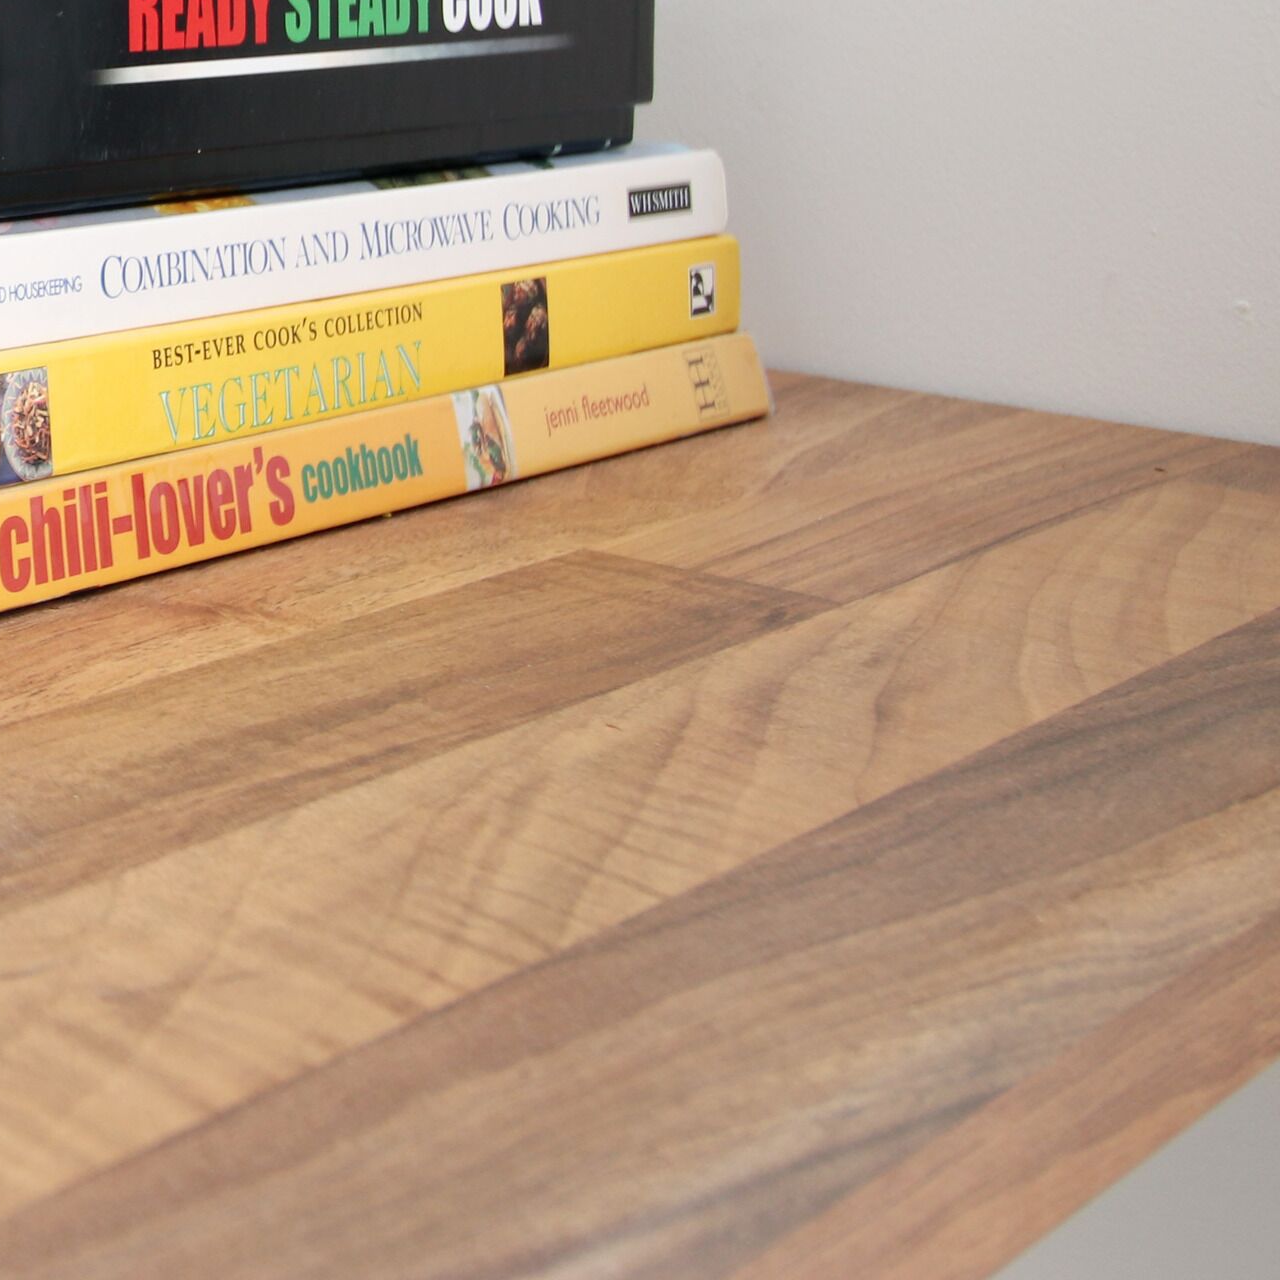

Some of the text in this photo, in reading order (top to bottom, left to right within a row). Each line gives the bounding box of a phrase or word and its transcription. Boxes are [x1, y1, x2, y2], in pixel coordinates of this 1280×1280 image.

[8, 275, 83, 303] HOUSEKEEPING
[100, 238, 287, 300] COMBINATION
[294, 230, 349, 268] AND
[359, 209, 494, 260] MICROWAVE
[502, 195, 600, 241] COOKING
[151, 302, 423, 370] BEST-EVER COOK'S COLLECTION
[159, 341, 423, 444] VEGETARIAN
[543, 401, 579, 438] jenni
[581, 382, 650, 420] fleetwood
[301, 433, 424, 503] cookbook
